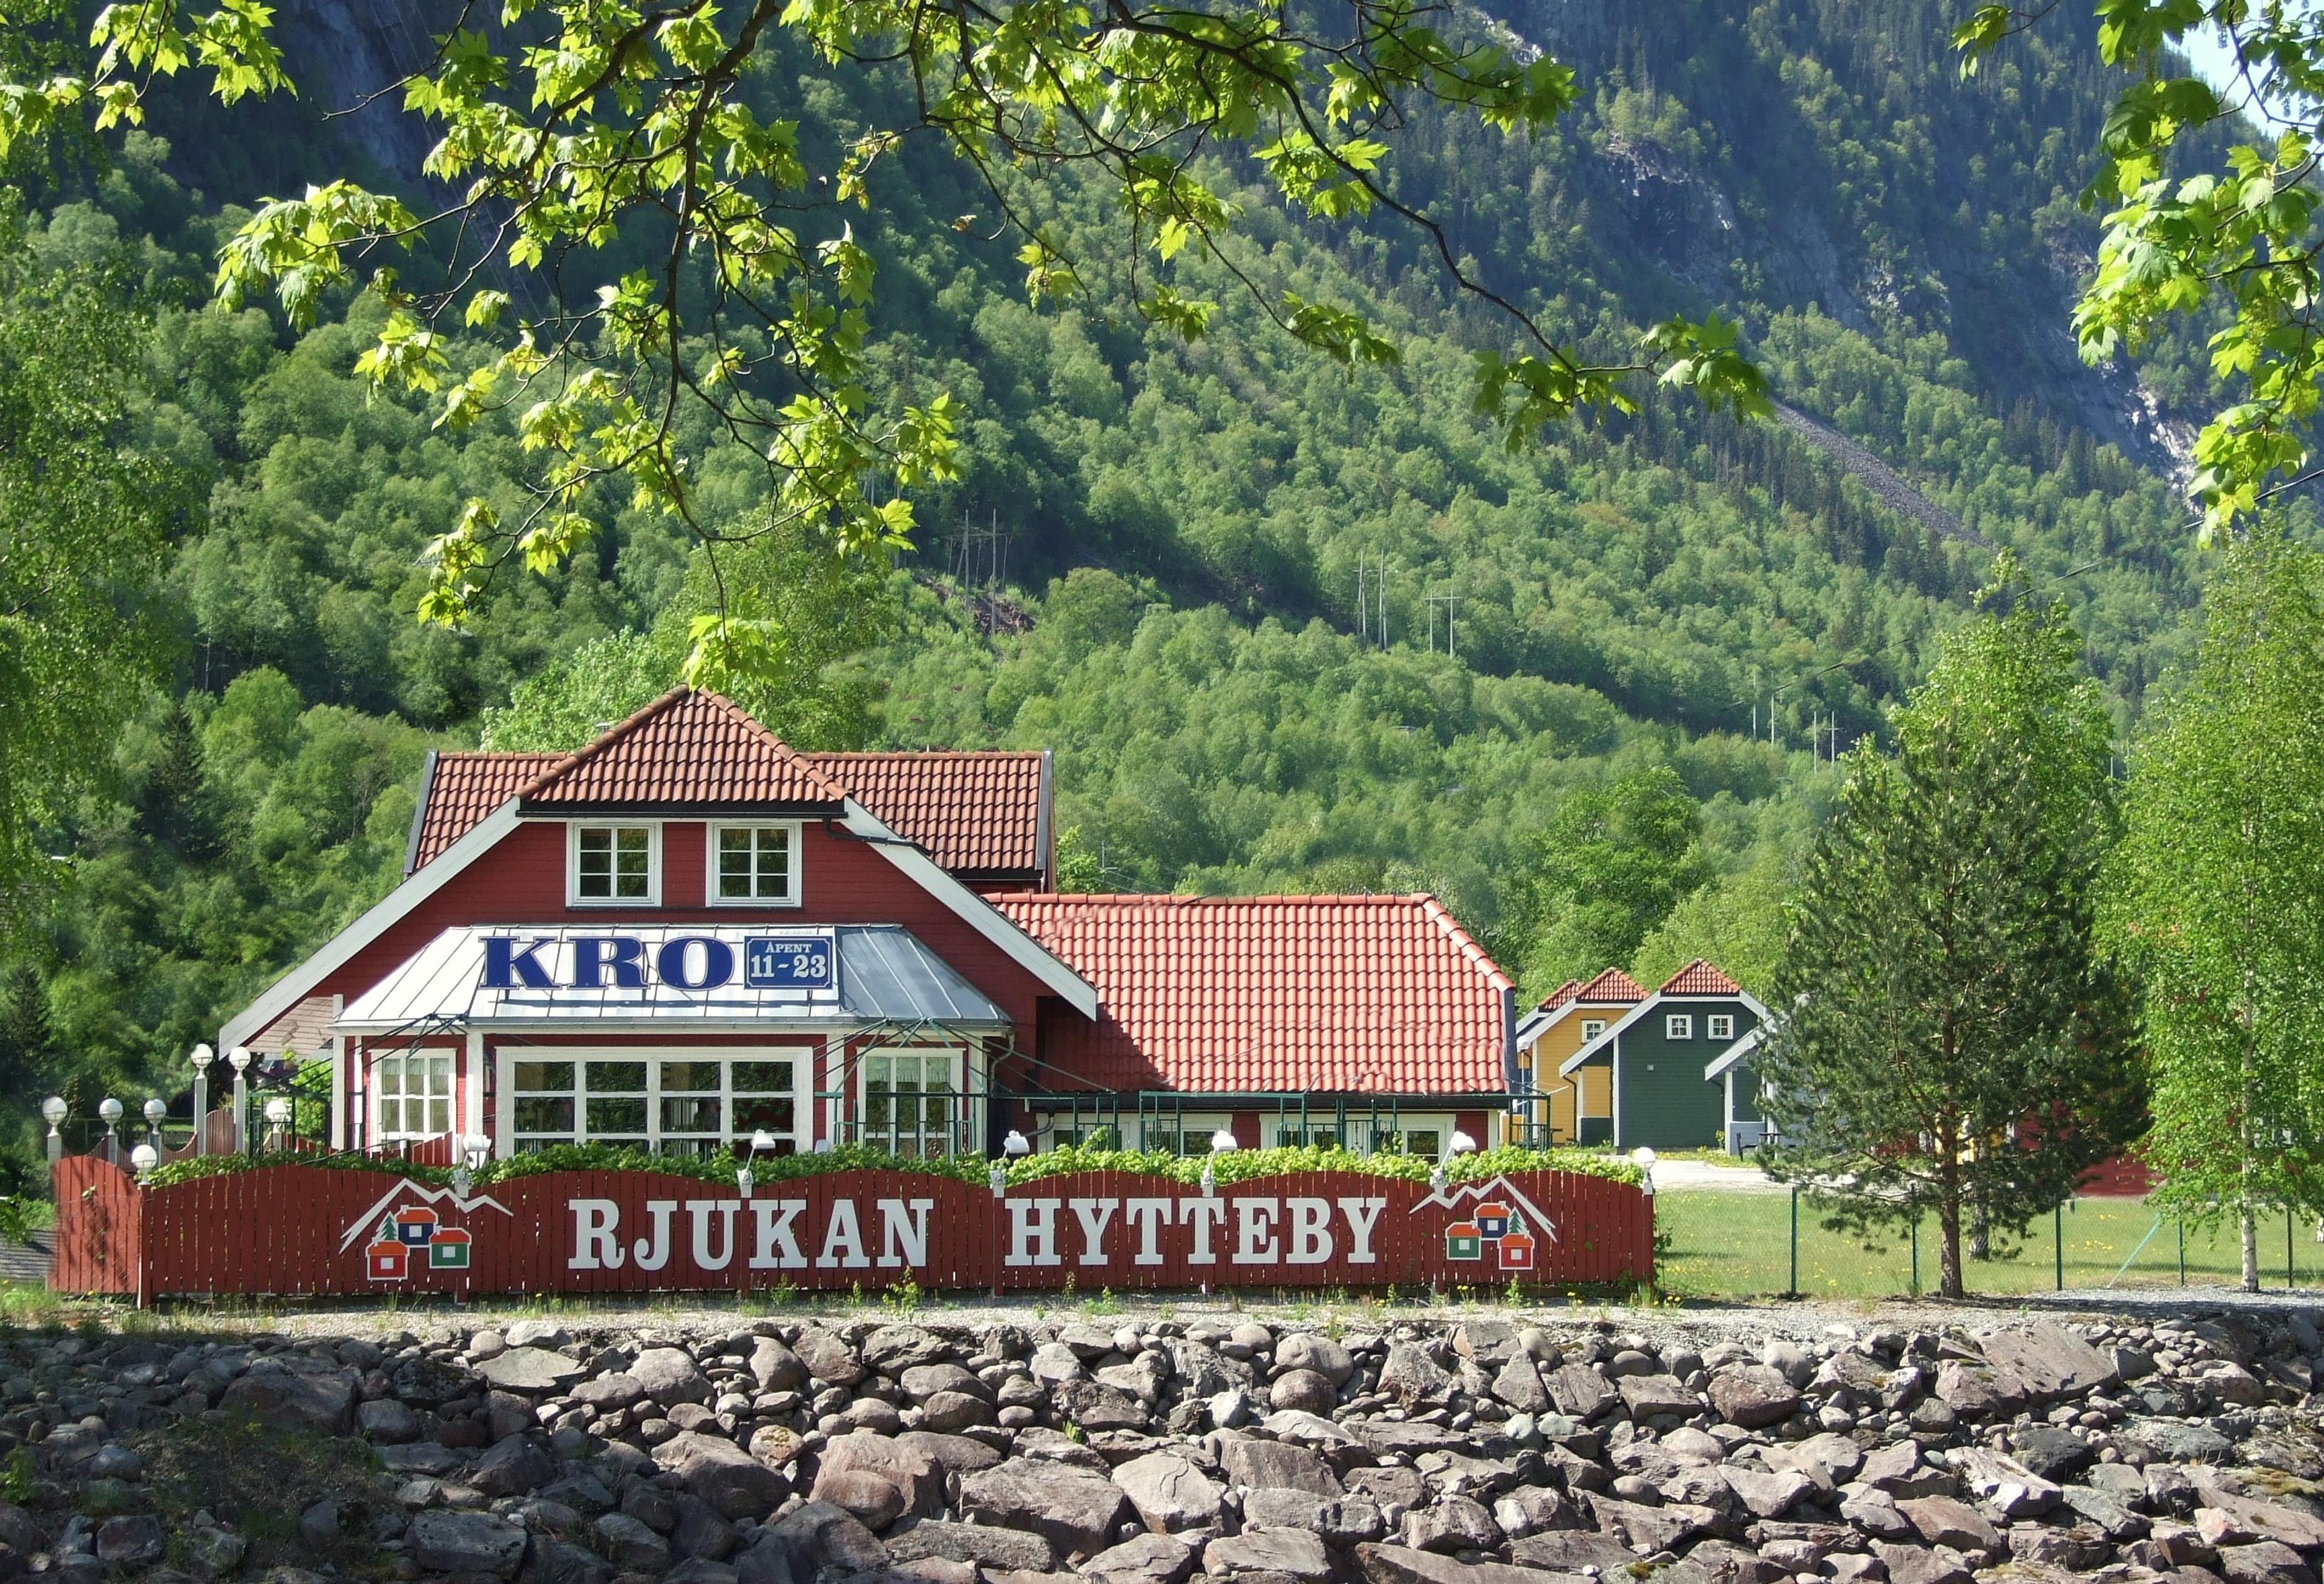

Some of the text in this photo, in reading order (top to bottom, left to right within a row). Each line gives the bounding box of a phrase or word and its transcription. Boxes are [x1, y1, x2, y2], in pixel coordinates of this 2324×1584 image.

[479, 936, 735, 991] KRO
[568, 1198, 1386, 1270] RJUKAN HYTTEBY
